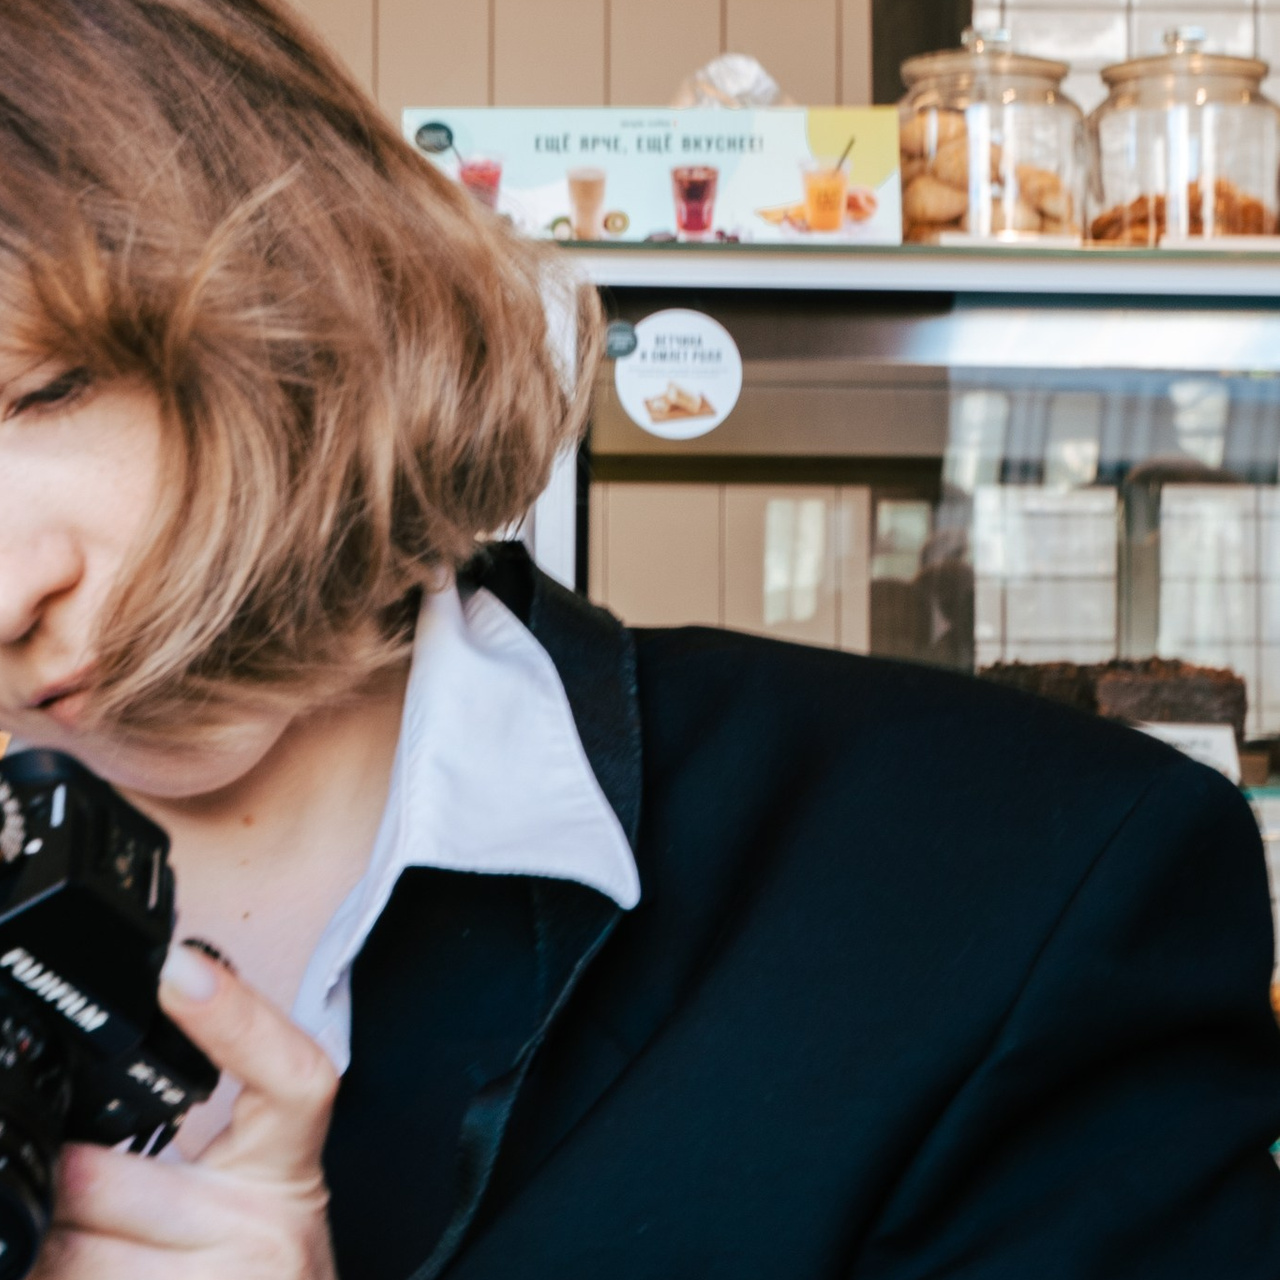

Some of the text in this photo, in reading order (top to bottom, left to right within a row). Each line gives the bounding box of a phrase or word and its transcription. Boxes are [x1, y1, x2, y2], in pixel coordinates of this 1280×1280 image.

[535, 131, 571, 153] ЕЩЁ
[637, 131, 673, 153] ЕЩЁ
[682, 134, 764, 153] ВКУСНЕЕ!
